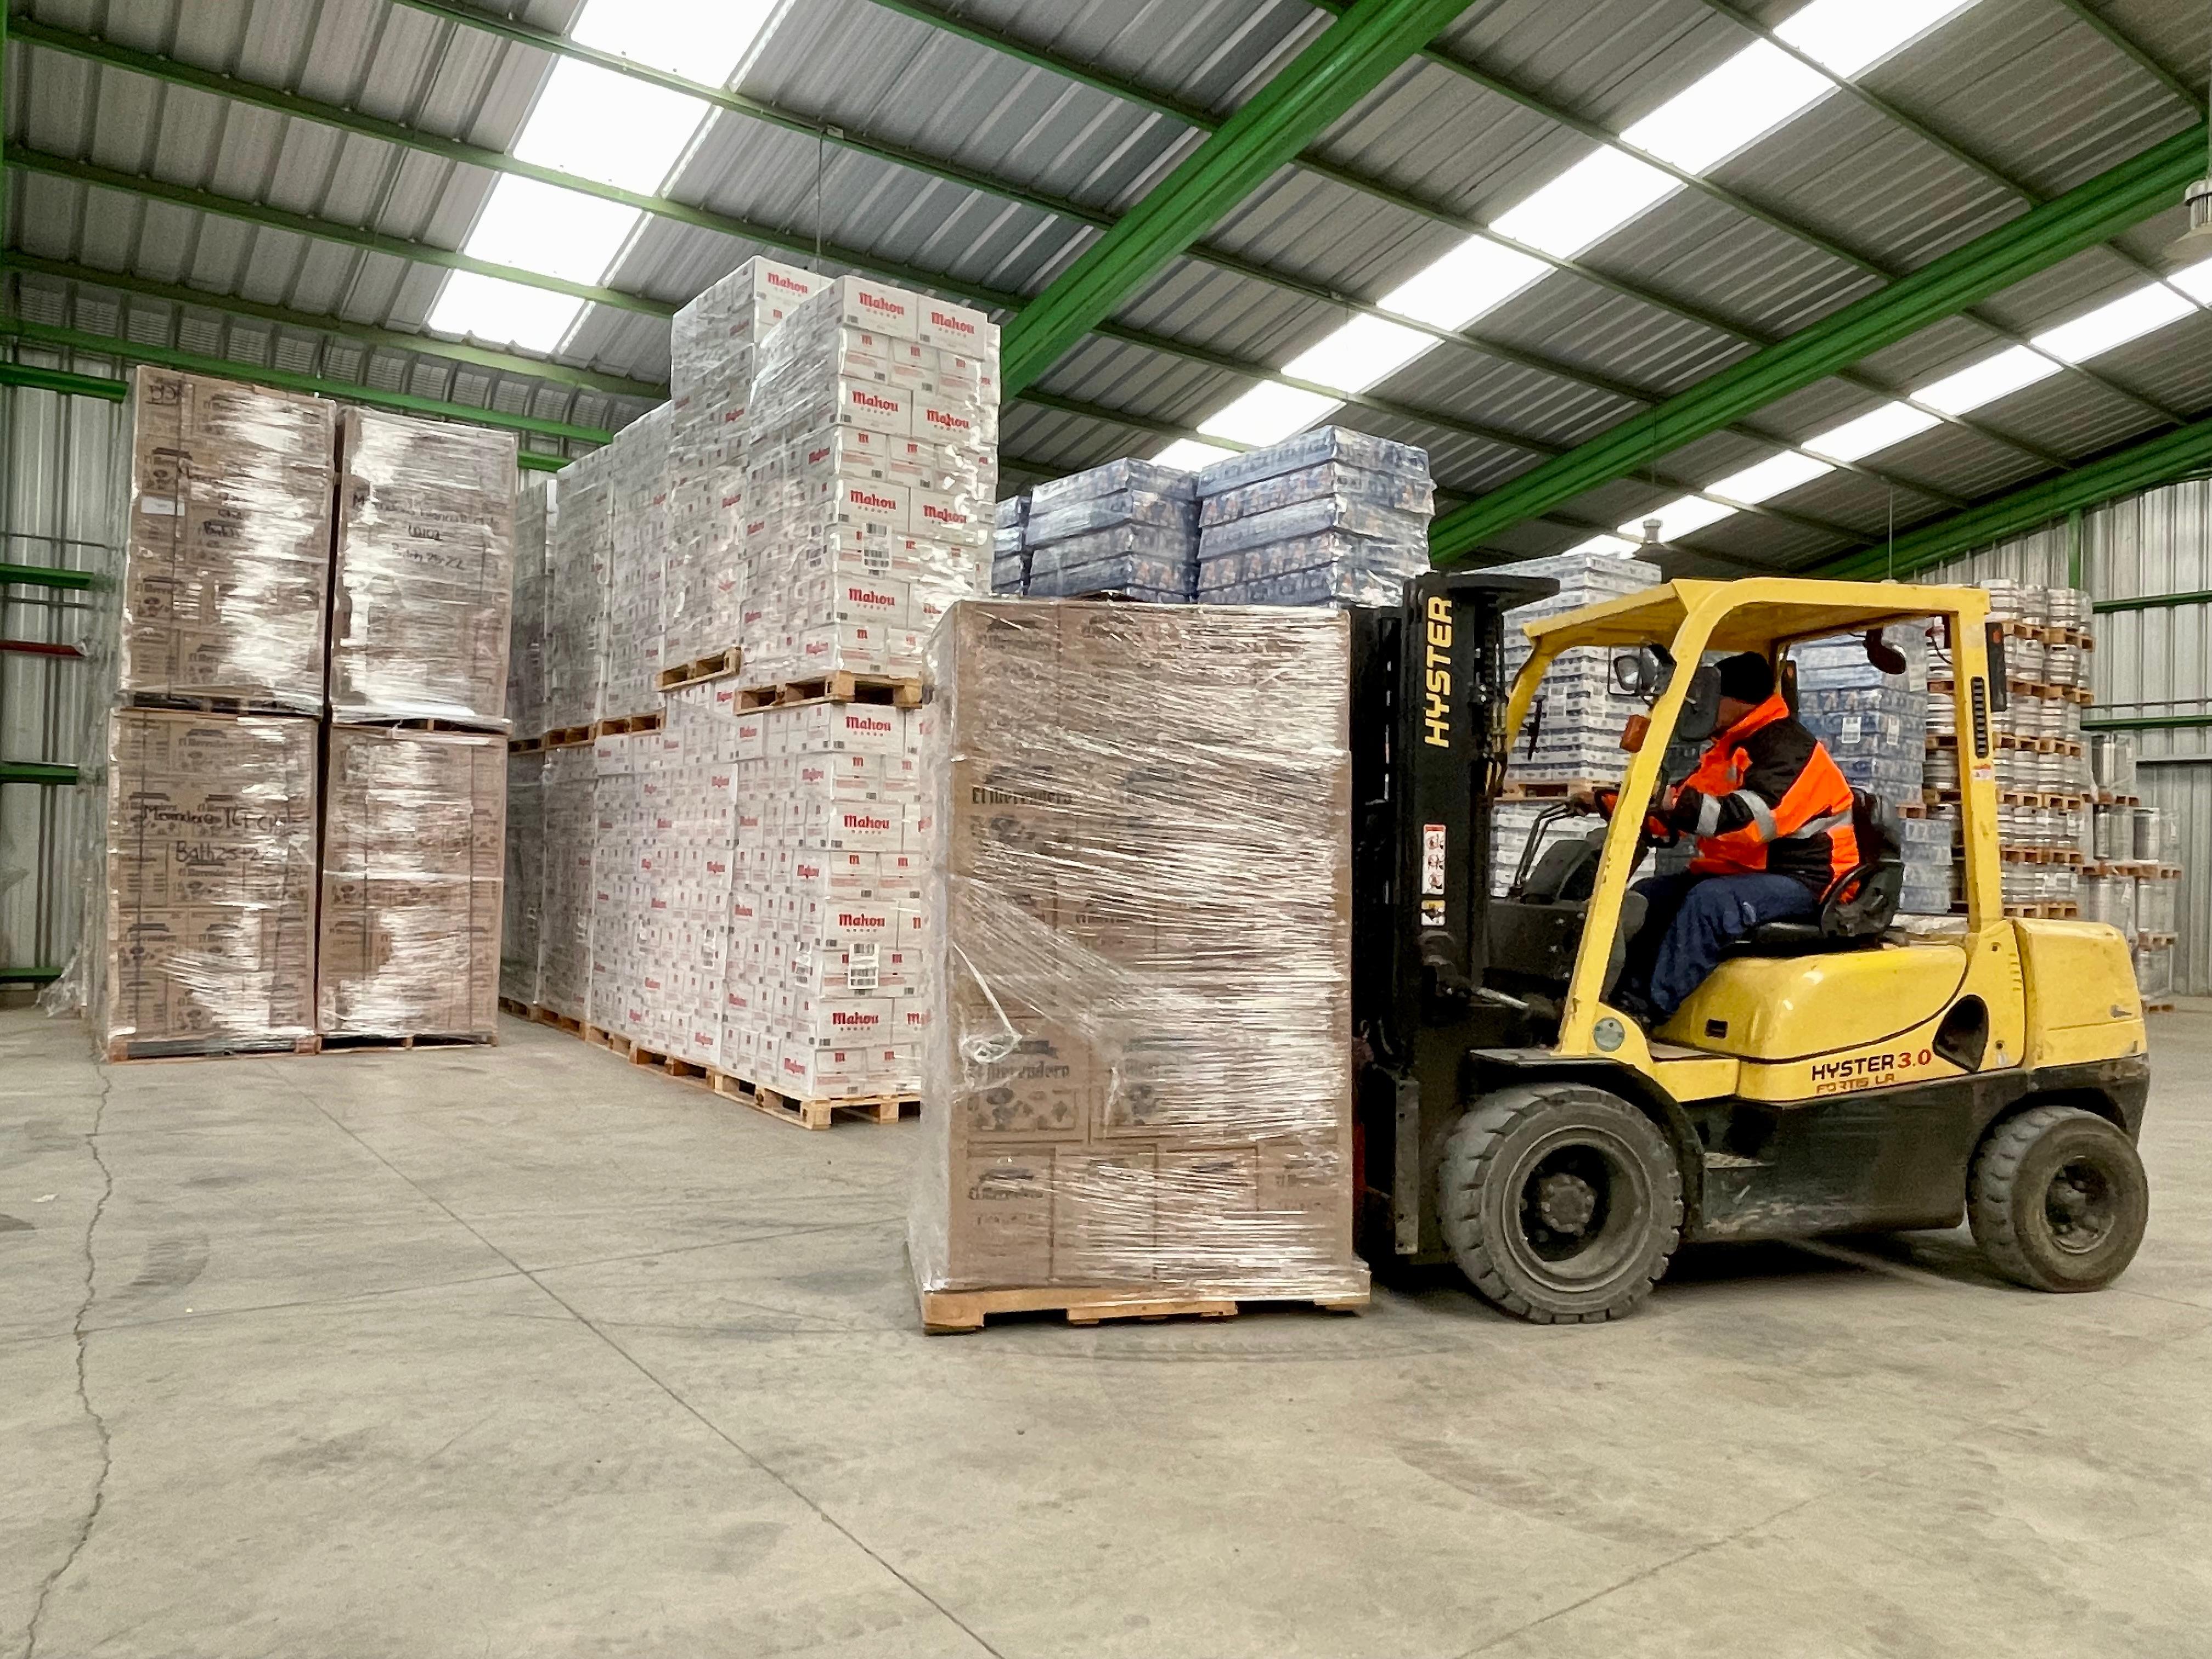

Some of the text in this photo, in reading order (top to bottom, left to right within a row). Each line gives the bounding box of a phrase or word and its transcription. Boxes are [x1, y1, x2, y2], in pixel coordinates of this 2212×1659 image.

[768, 272, 808, 294] Mahou
[859, 292, 904, 315] Mahou
[931, 312, 974, 334] Mahou
[853, 391, 899, 412] Mahou
[926, 409, 969, 429] Mahou
[851, 490, 896, 510] Mahou
[848, 588, 895, 606] Mahou
[1424, 596, 1453, 748] HYSTER
[845, 716, 891, 732] Mahou
[844, 814, 890, 830] Mahou
[838, 913, 885, 927] Mahou
[832, 1012, 879, 1025] Mahou
[1812, 1049, 1932, 1081] HYSTER 3.0
